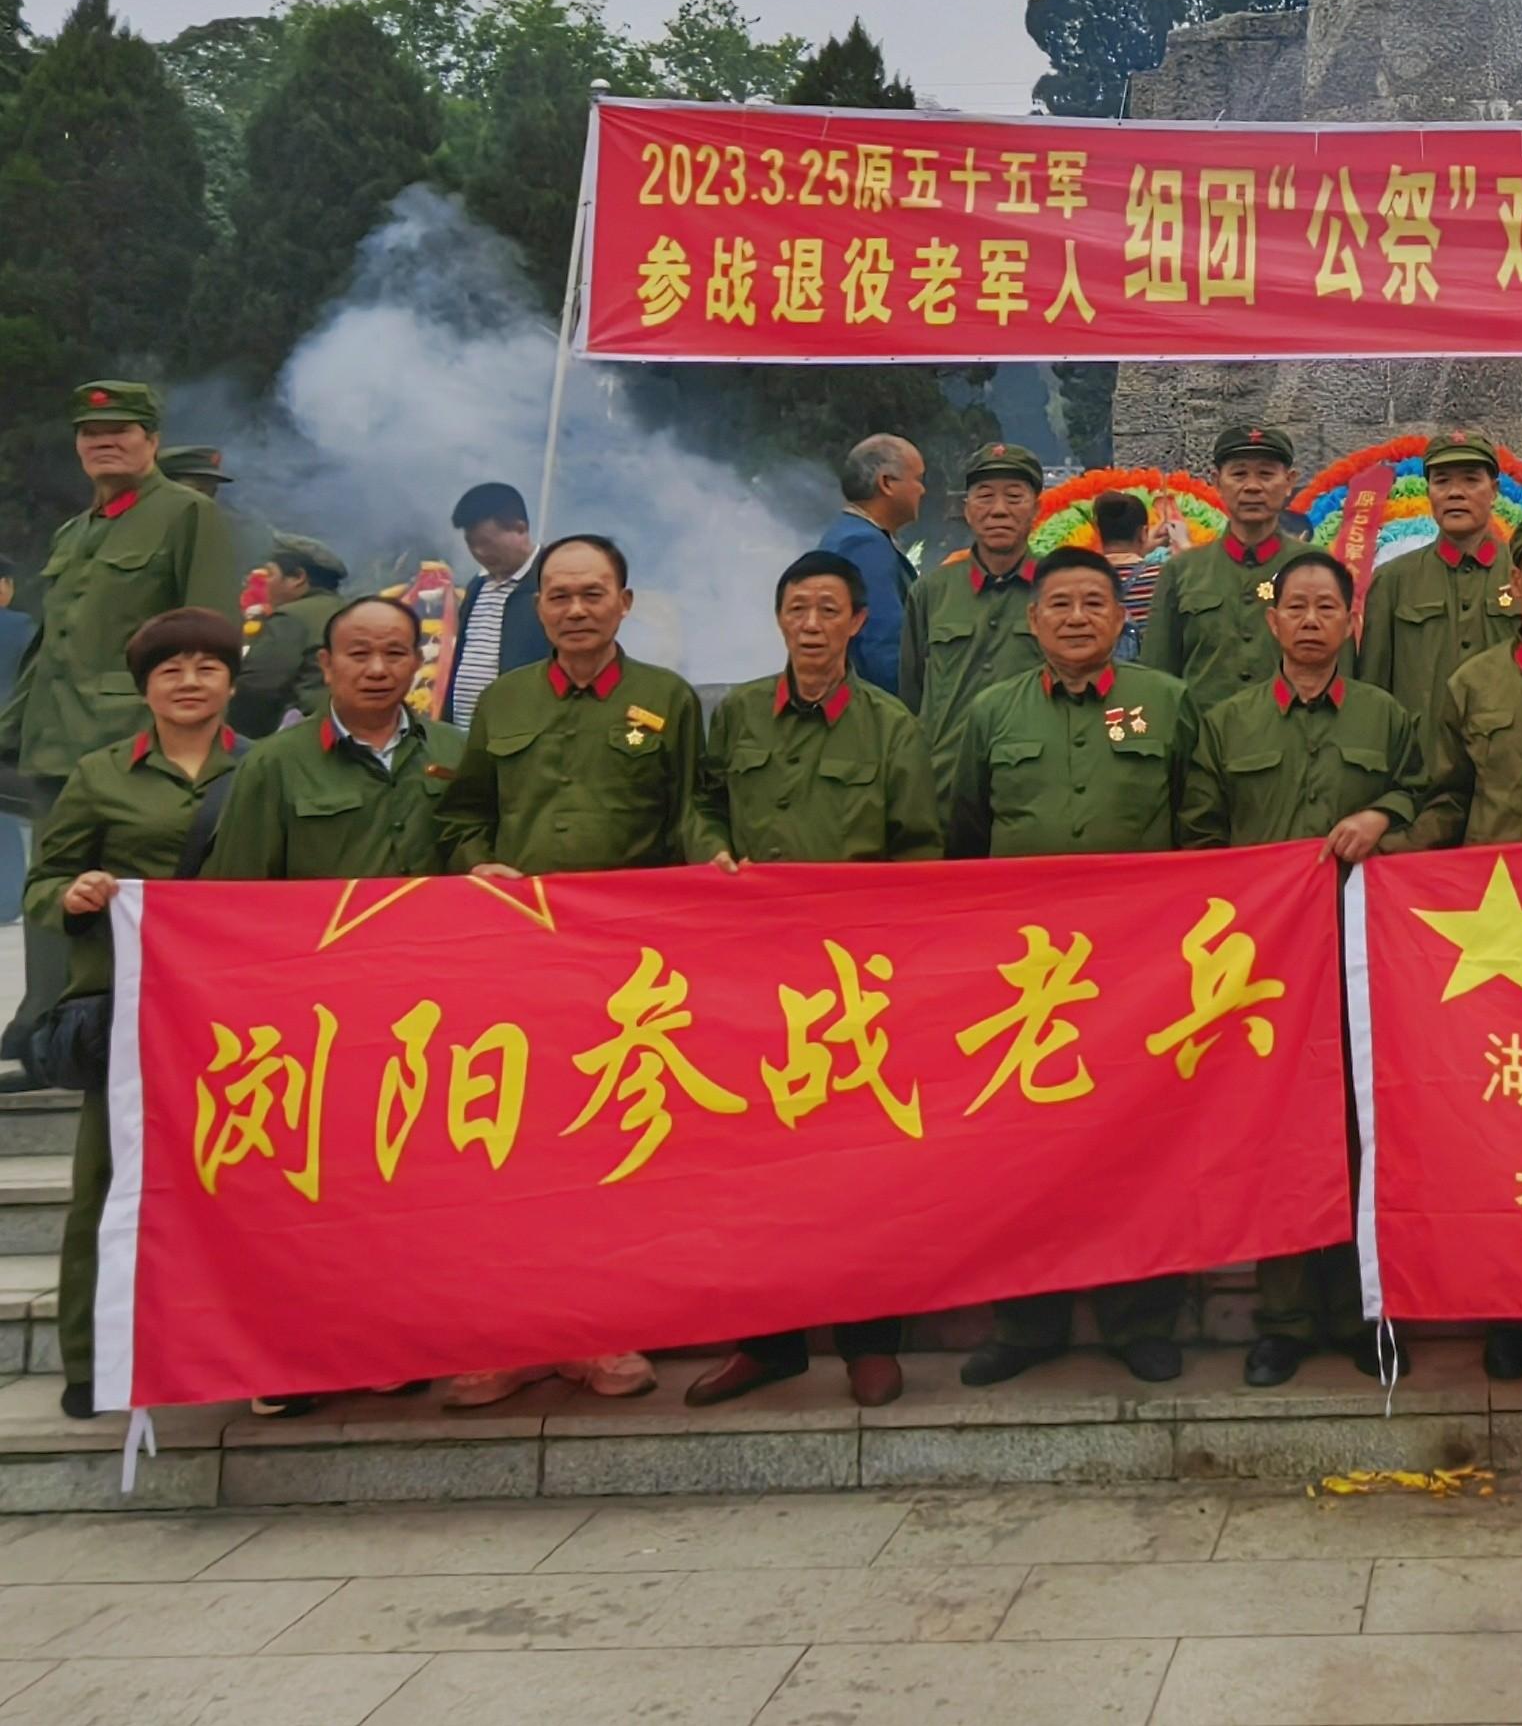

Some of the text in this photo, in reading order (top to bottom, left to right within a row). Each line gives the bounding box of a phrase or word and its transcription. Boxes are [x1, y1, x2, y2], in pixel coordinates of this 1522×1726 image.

[638, 142, 1090, 220] 2023.3.25原五十五军
[637, 234, 1097, 327] 参战退役老军人
[195, 897, 1285, 1202] 浏阳参战老兵
